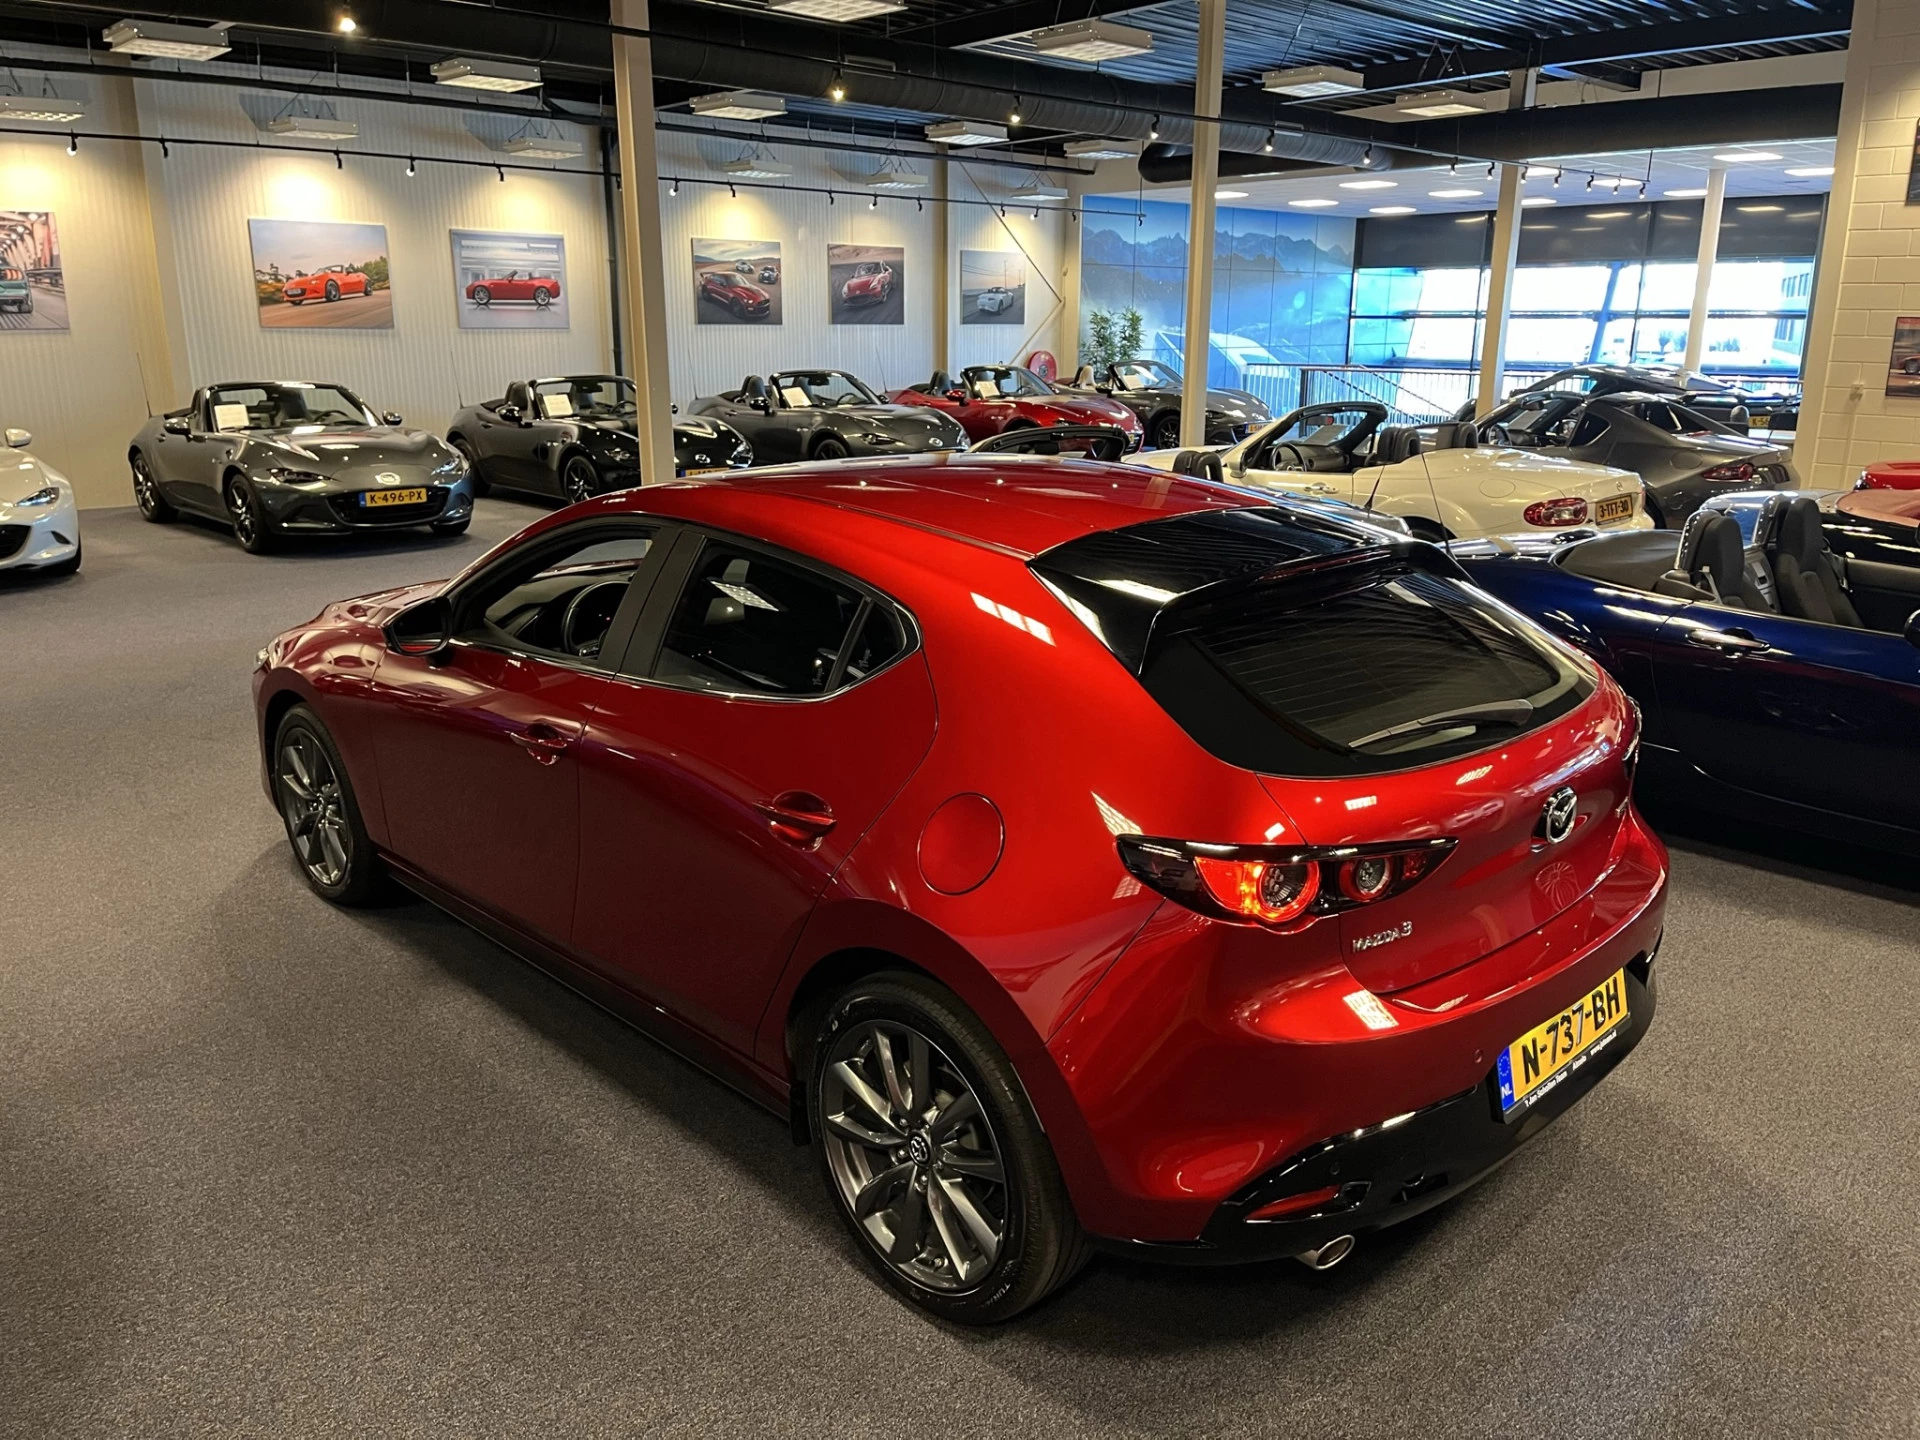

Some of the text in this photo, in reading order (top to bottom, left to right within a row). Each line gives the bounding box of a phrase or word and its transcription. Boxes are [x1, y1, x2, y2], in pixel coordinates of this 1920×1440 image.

[369, 490, 423, 505] K-496-PX
[1352, 920, 1413, 954] MAZDA 3
[1521, 976, 1621, 1085] N-737-BH
[1500, 1082, 1513, 1099] NL
